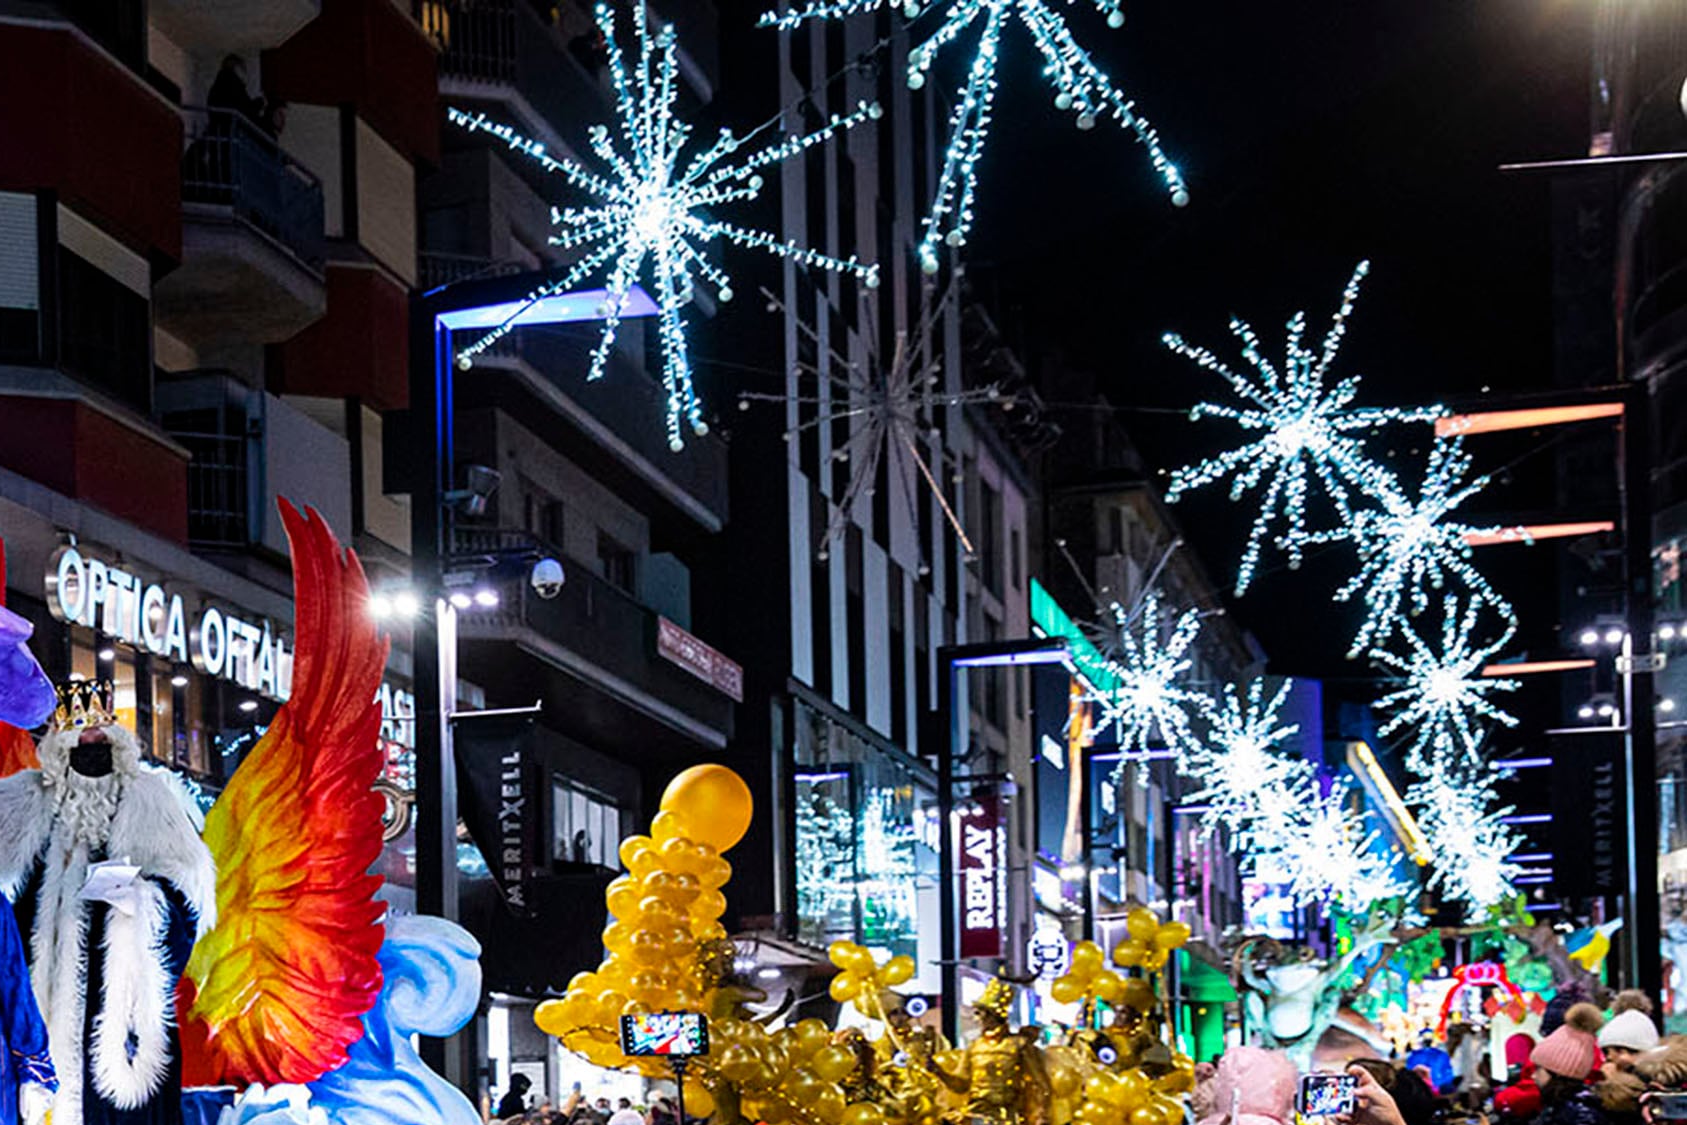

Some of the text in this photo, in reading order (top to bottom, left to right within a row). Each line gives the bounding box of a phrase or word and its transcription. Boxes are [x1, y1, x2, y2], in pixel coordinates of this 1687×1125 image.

[58, 534, 187, 662] ÒPTICA
[201, 608, 293, 702] OFTÀL
[498, 751, 525, 907] MERITXELL
[965, 825, 993, 929] REPLAY
[1590, 760, 1614, 887] MERITXELL
